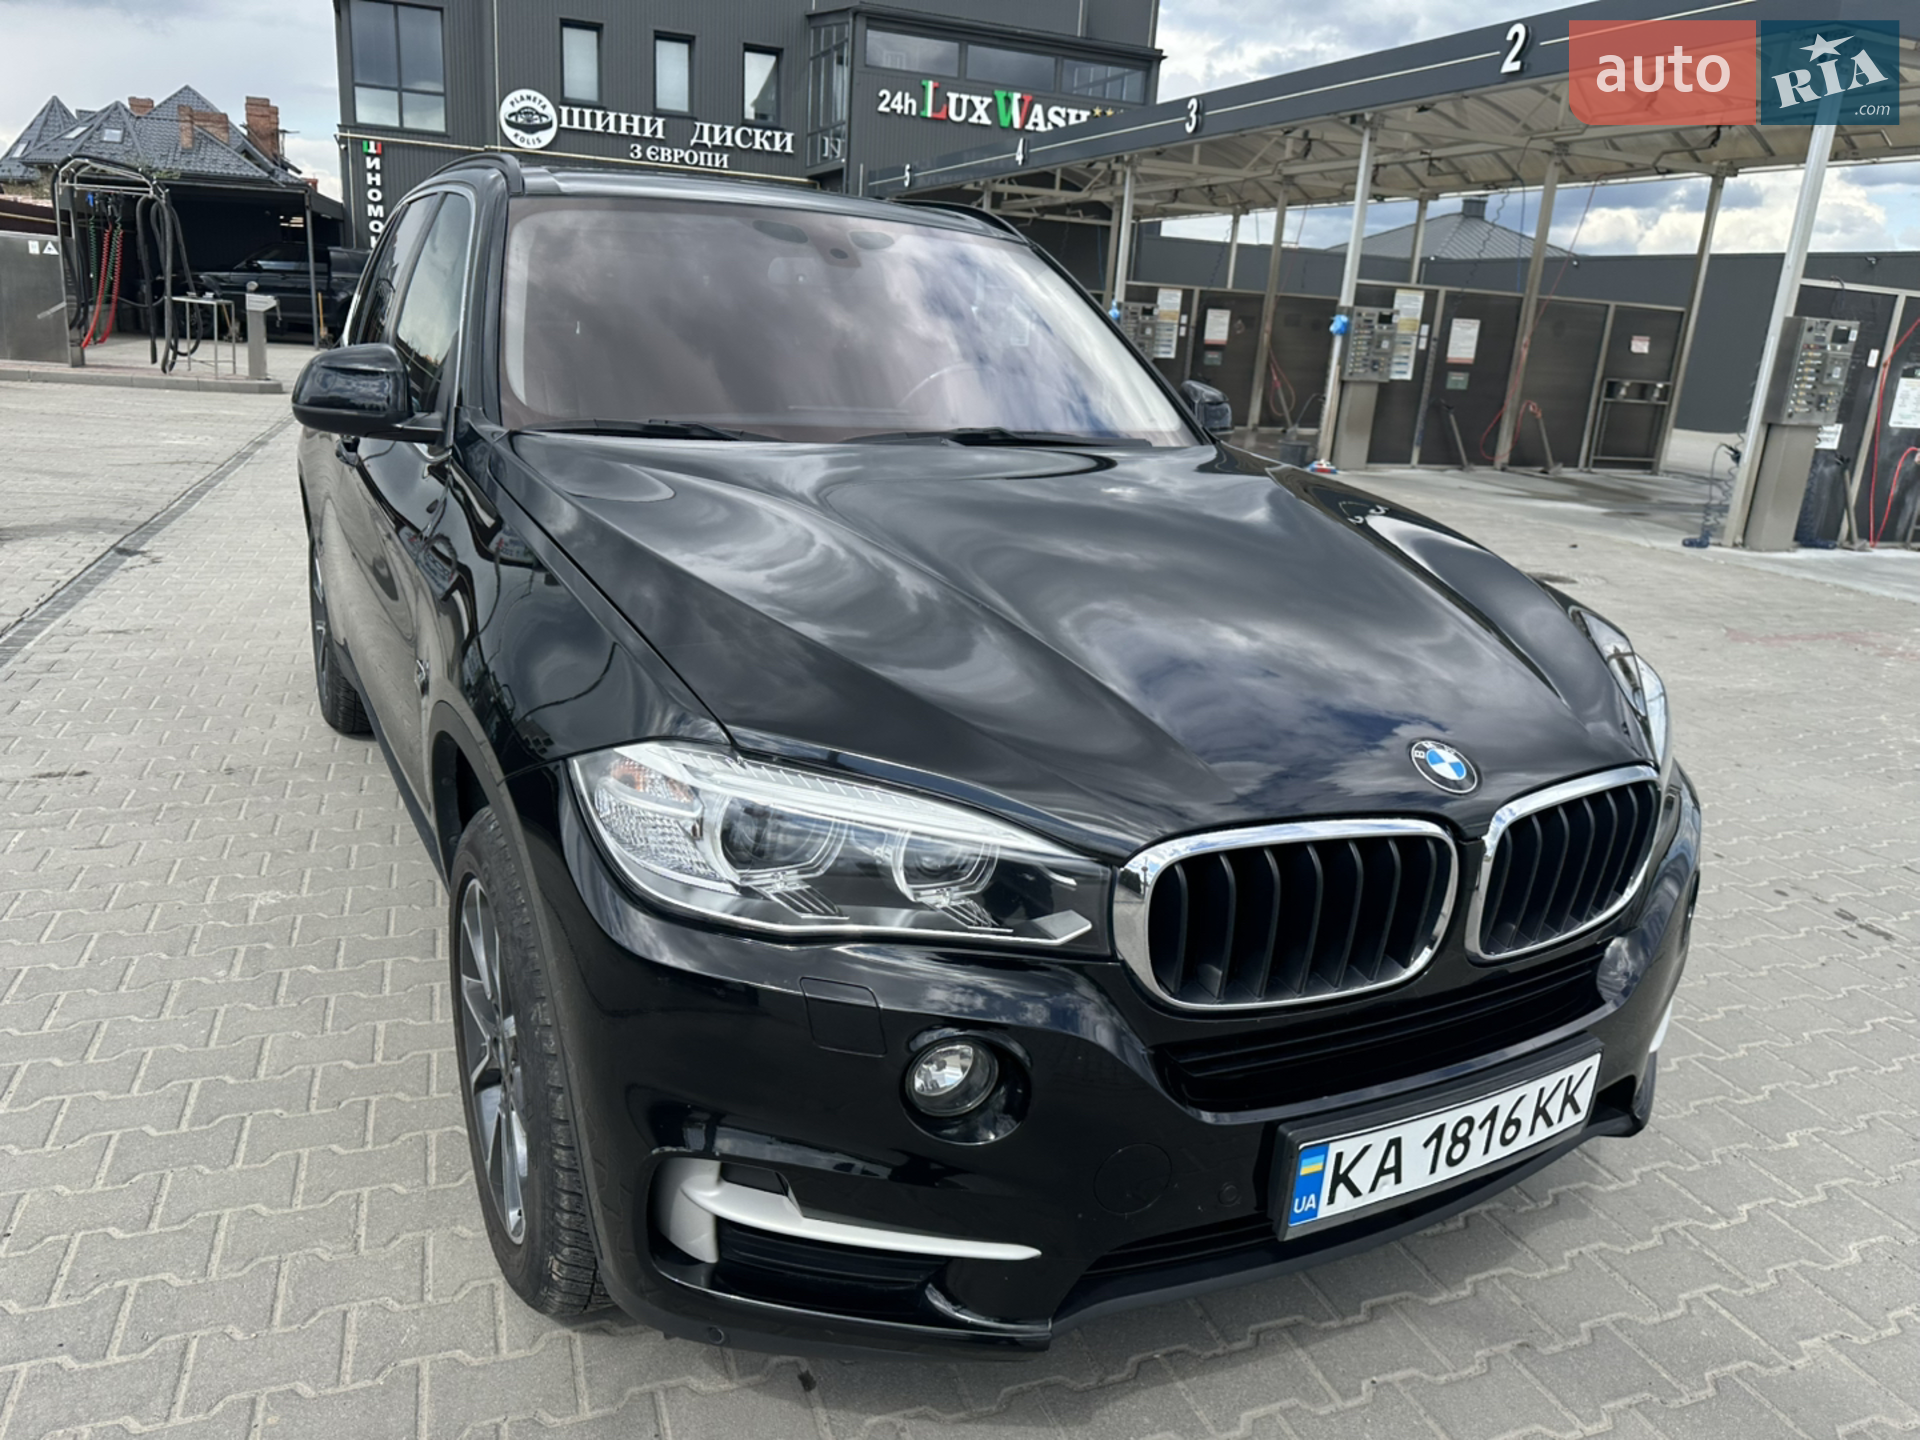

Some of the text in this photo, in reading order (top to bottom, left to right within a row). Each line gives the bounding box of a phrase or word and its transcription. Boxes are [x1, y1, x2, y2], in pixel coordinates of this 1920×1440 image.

[1500, 23, 1526, 73] 2
[509, 94, 548, 111] PLANETA
[877, 89, 917, 116] 24h
[1185, 98, 1198, 134] 3
[513, 132, 542, 145] KOLIS
[559, 105, 795, 154] ШИНИ ДИСКИ
[646, 146, 730, 169] ЄВРОПИ
[1015, 137, 1024, 166] 4
[1326, 1065, 1593, 1206] KA 1816 KK
[1293, 1195, 1317, 1214] UA
